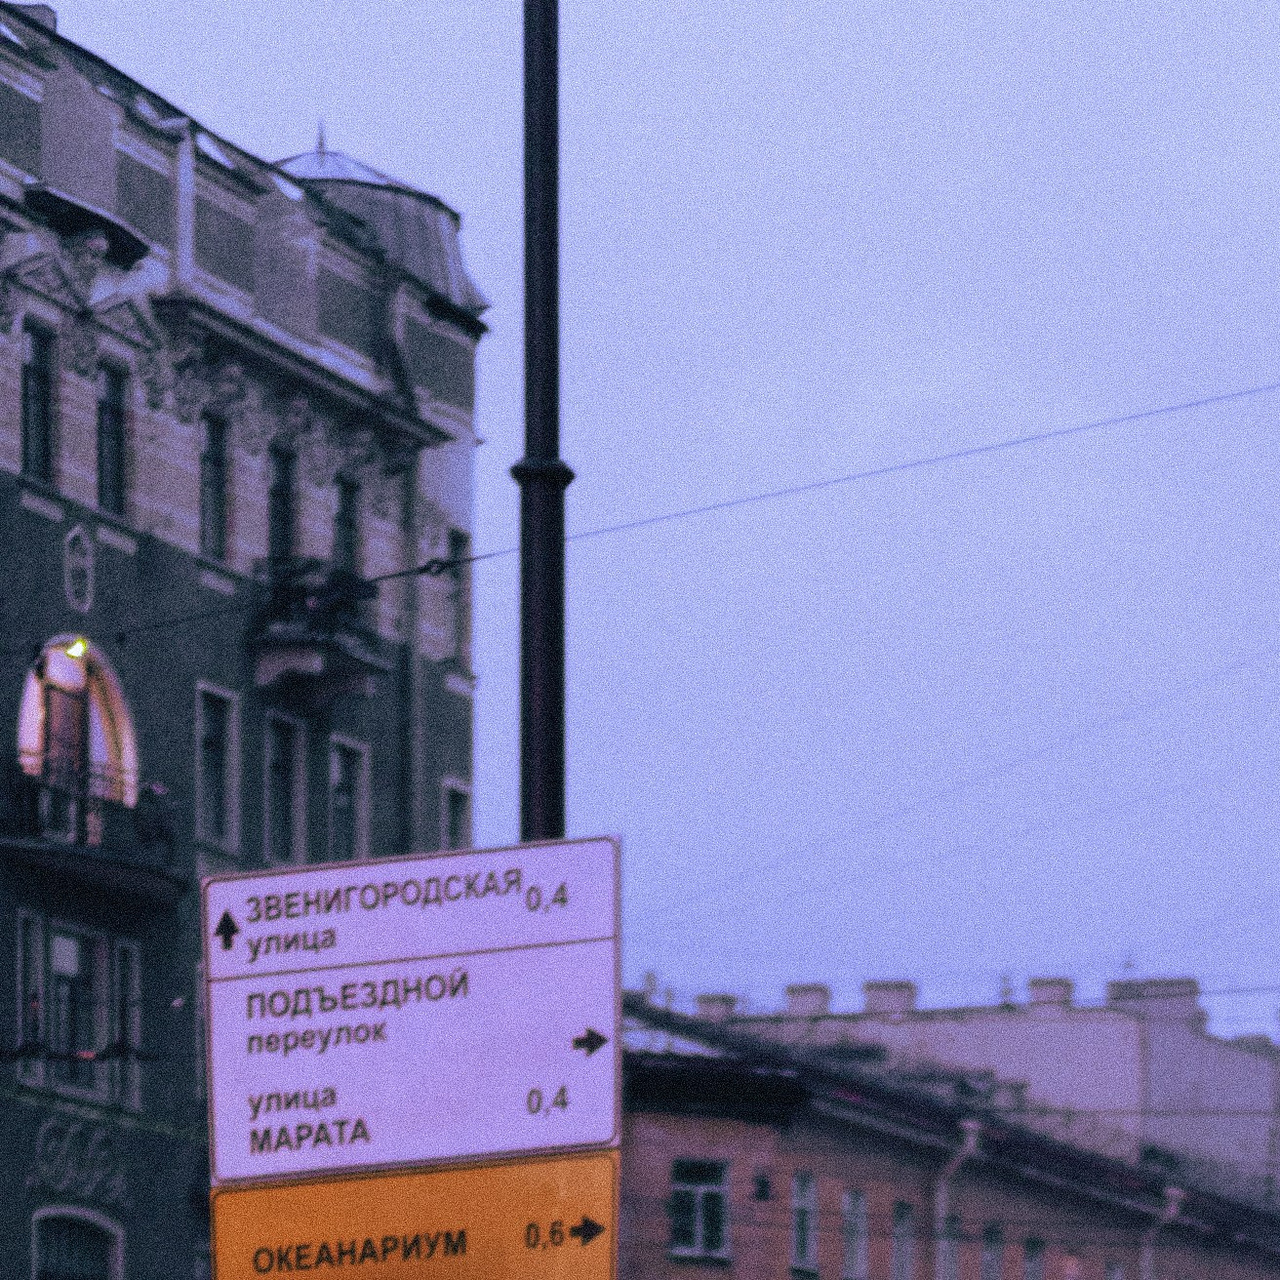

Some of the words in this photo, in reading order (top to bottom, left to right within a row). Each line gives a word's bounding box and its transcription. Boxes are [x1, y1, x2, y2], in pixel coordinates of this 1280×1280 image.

[247, 869, 522, 923] ЗВЕНИГОРОДСКАЯ
[526, 883, 568, 915] 0,4
[248, 926, 336, 962] улица
[247, 967, 469, 1020] ПОДЪЕЗДНОЙ
[247, 1021, 387, 1057] переулок
[248, 1085, 336, 1119] улица
[526, 1086, 568, 1117] 0,4
[249, 1118, 371, 1154] МАРАТА
[252, 1229, 467, 1275] ОКЕАНАРИУМ
[524, 1220, 564, 1251] 0,6
